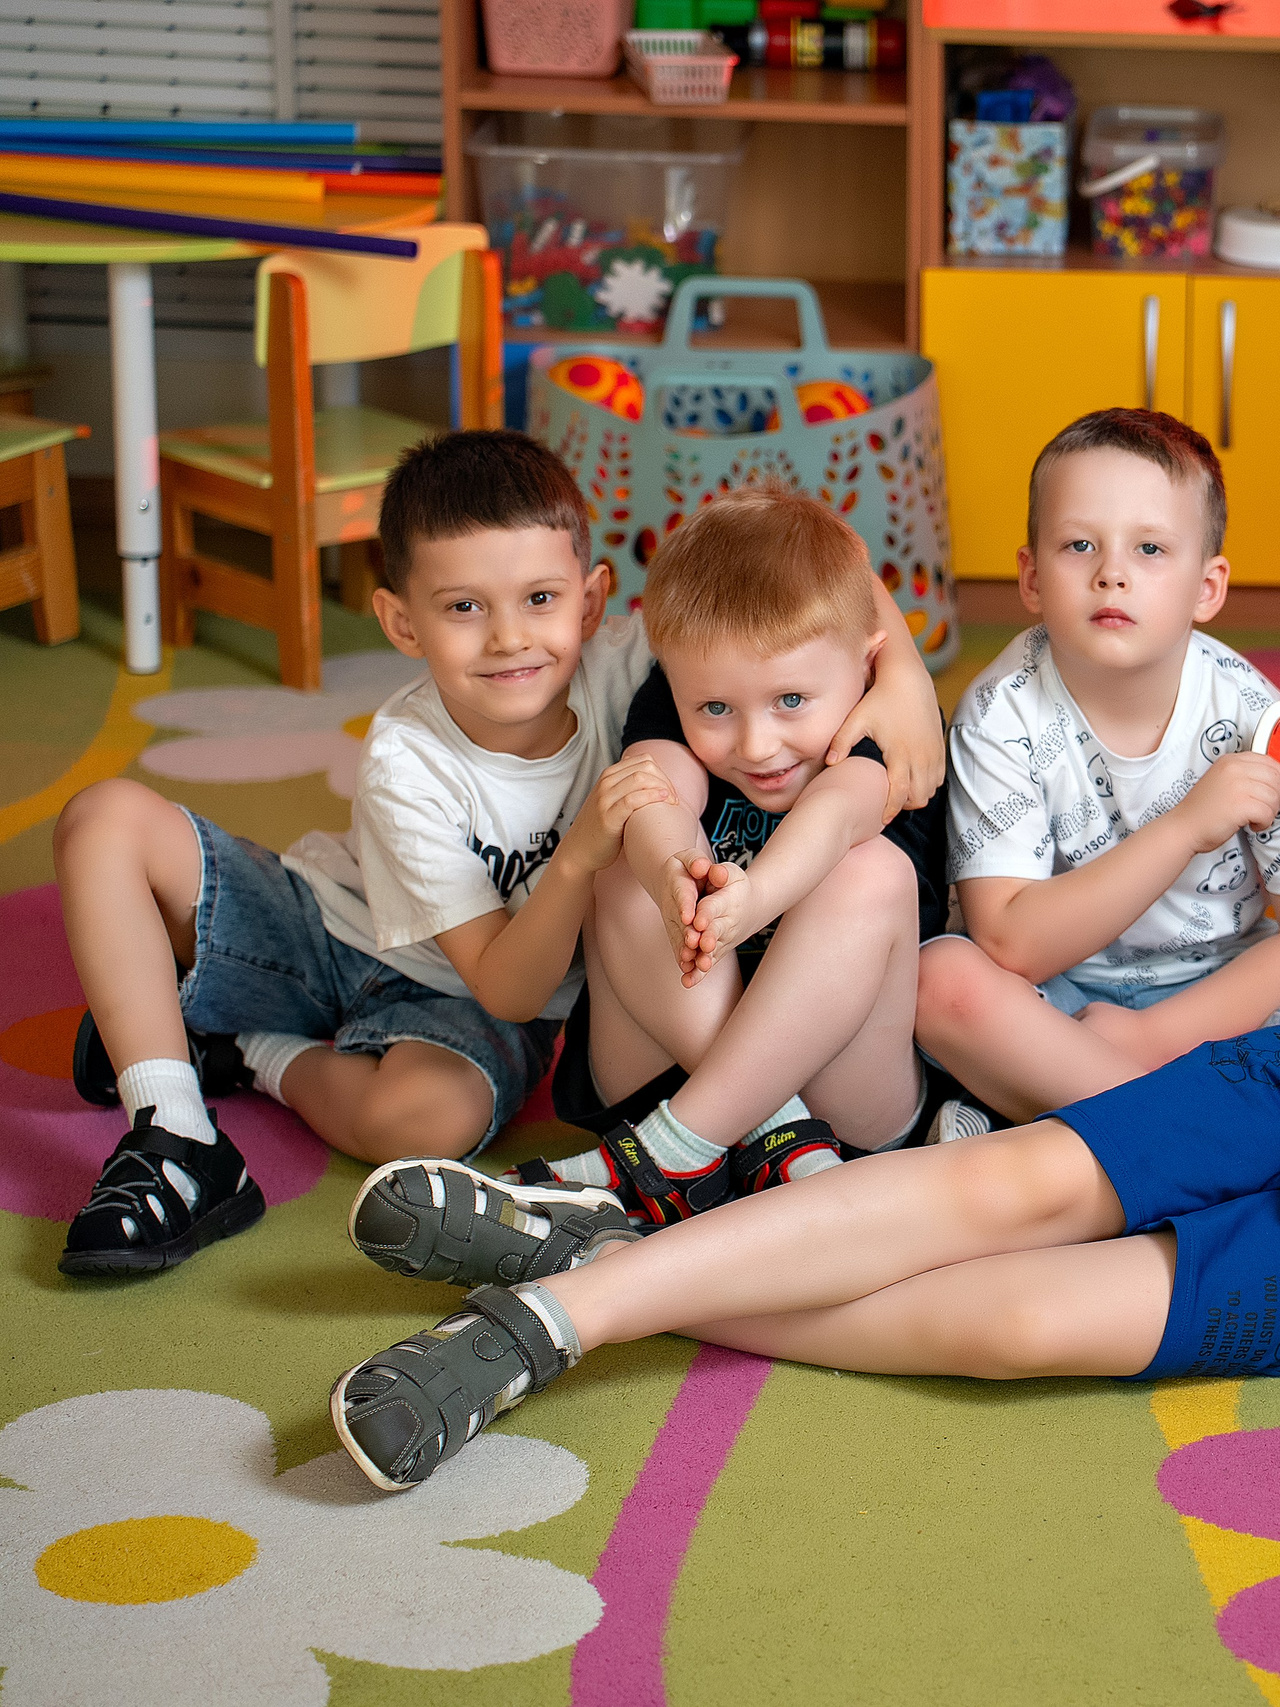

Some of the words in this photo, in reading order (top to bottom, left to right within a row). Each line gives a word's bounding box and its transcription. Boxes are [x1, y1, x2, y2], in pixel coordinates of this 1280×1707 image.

[616, 1136, 642, 1167] Ritm
[764, 1129, 797, 1153] Ritm
[1226, 1290, 1241, 1307] TO
[1263, 1274, 1278, 1303] YOU
[1198, 1307, 1222, 1357] OTHERS
[1213, 1311, 1239, 1363] ACHIEVE
[1233, 1311, 1259, 1360] OTHERS
[1258, 1308, 1278, 1345] MUST
